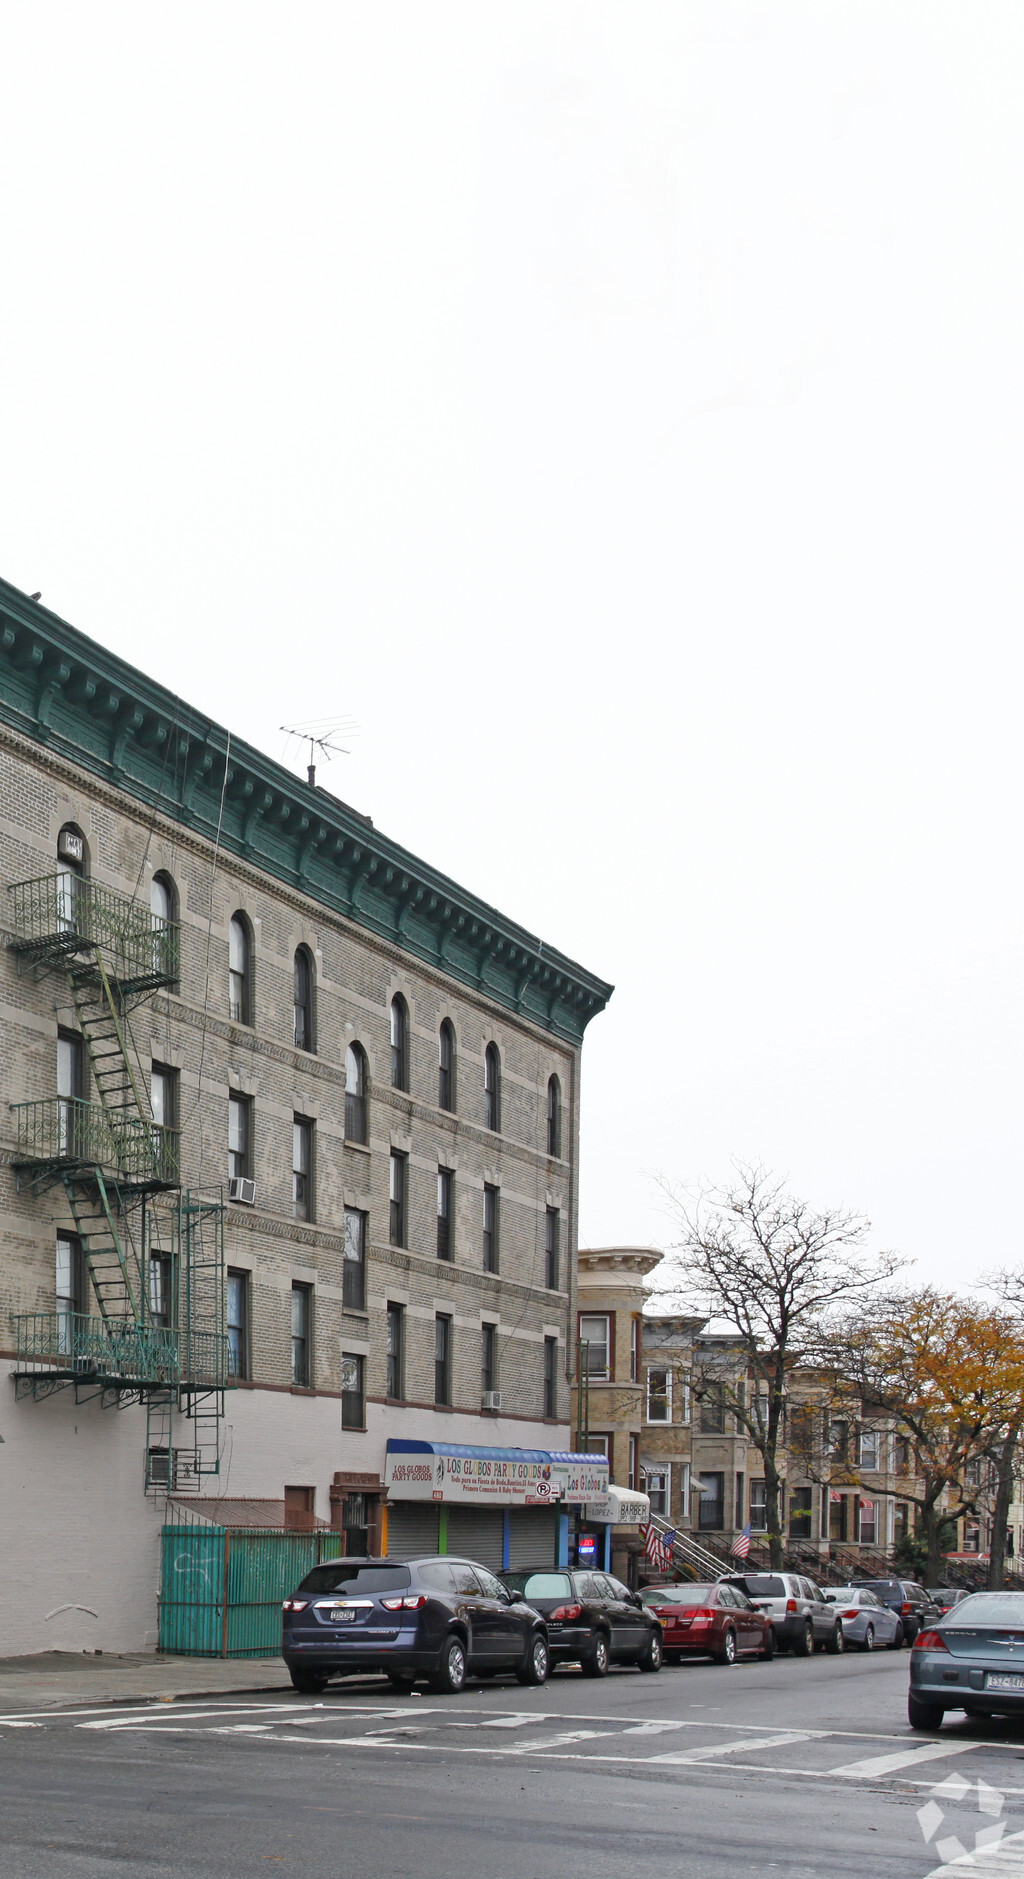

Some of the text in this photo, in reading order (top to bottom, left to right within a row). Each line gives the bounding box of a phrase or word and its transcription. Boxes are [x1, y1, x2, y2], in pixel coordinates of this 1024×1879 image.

[394, 1465, 430, 1473] LOS GLOBOS
[447, 1458, 461, 1474] LOS
[463, 1460, 491, 1476] GLOBOS
[494, 1462, 517, 1478] PARTY
[518, 1464, 542, 1479] GOODS
[392, 1473, 432, 1481] PARTY GOODS
[567, 1474, 579, 1490] Los
[580, 1474, 600, 1490] Globos
[620, 1504, 647, 1516] BARBER
